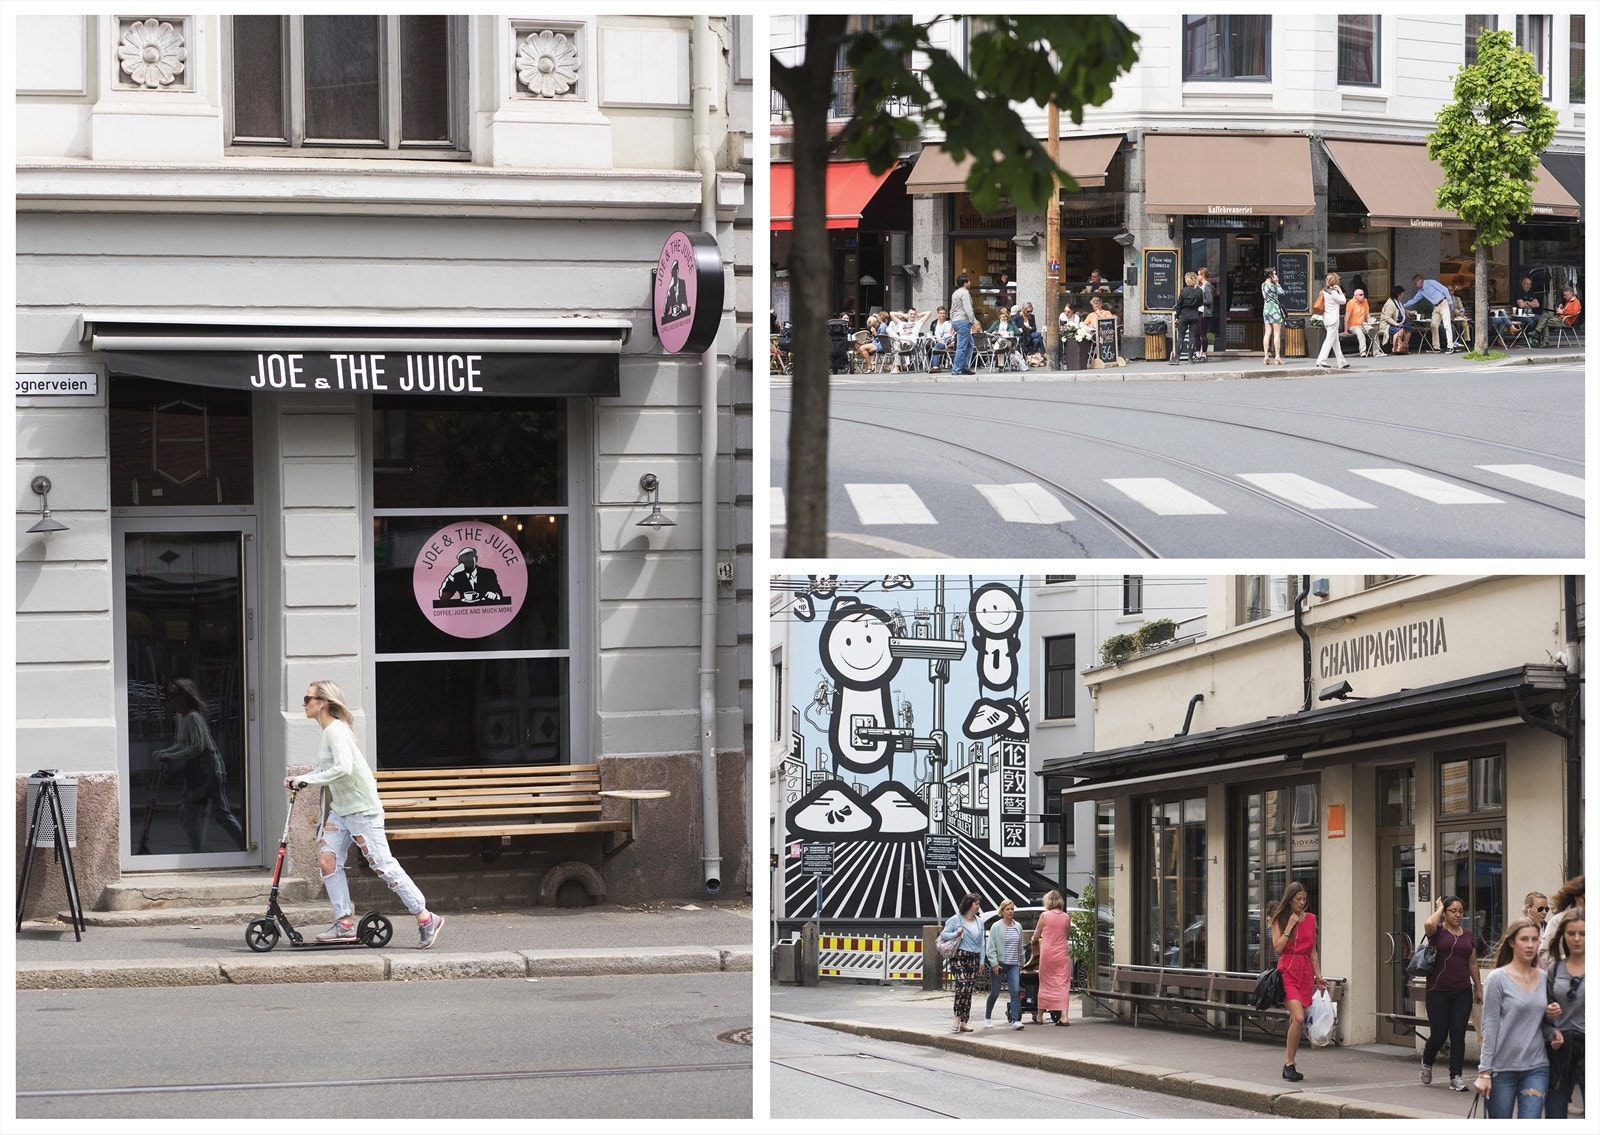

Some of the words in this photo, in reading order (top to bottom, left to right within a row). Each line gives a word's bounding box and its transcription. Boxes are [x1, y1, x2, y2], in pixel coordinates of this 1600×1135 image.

[1208, 205, 1253, 214] Kaffebrenneriet
[658, 261, 667, 286] JOE
[670, 239, 681, 254] THE
[681, 243, 695, 275] JUICE
[250, 354, 306, 388] JOE
[314, 378, 331, 389] &
[330, 354, 387, 390] THE
[400, 354, 483, 392] JUICE
[422, 543, 443, 570] JOE
[442, 534, 454, 547] &
[455, 528, 483, 541] THE
[485, 534, 519, 567] JUICE
[1320, 617, 1447, 679] CHAMPAGNERIA
